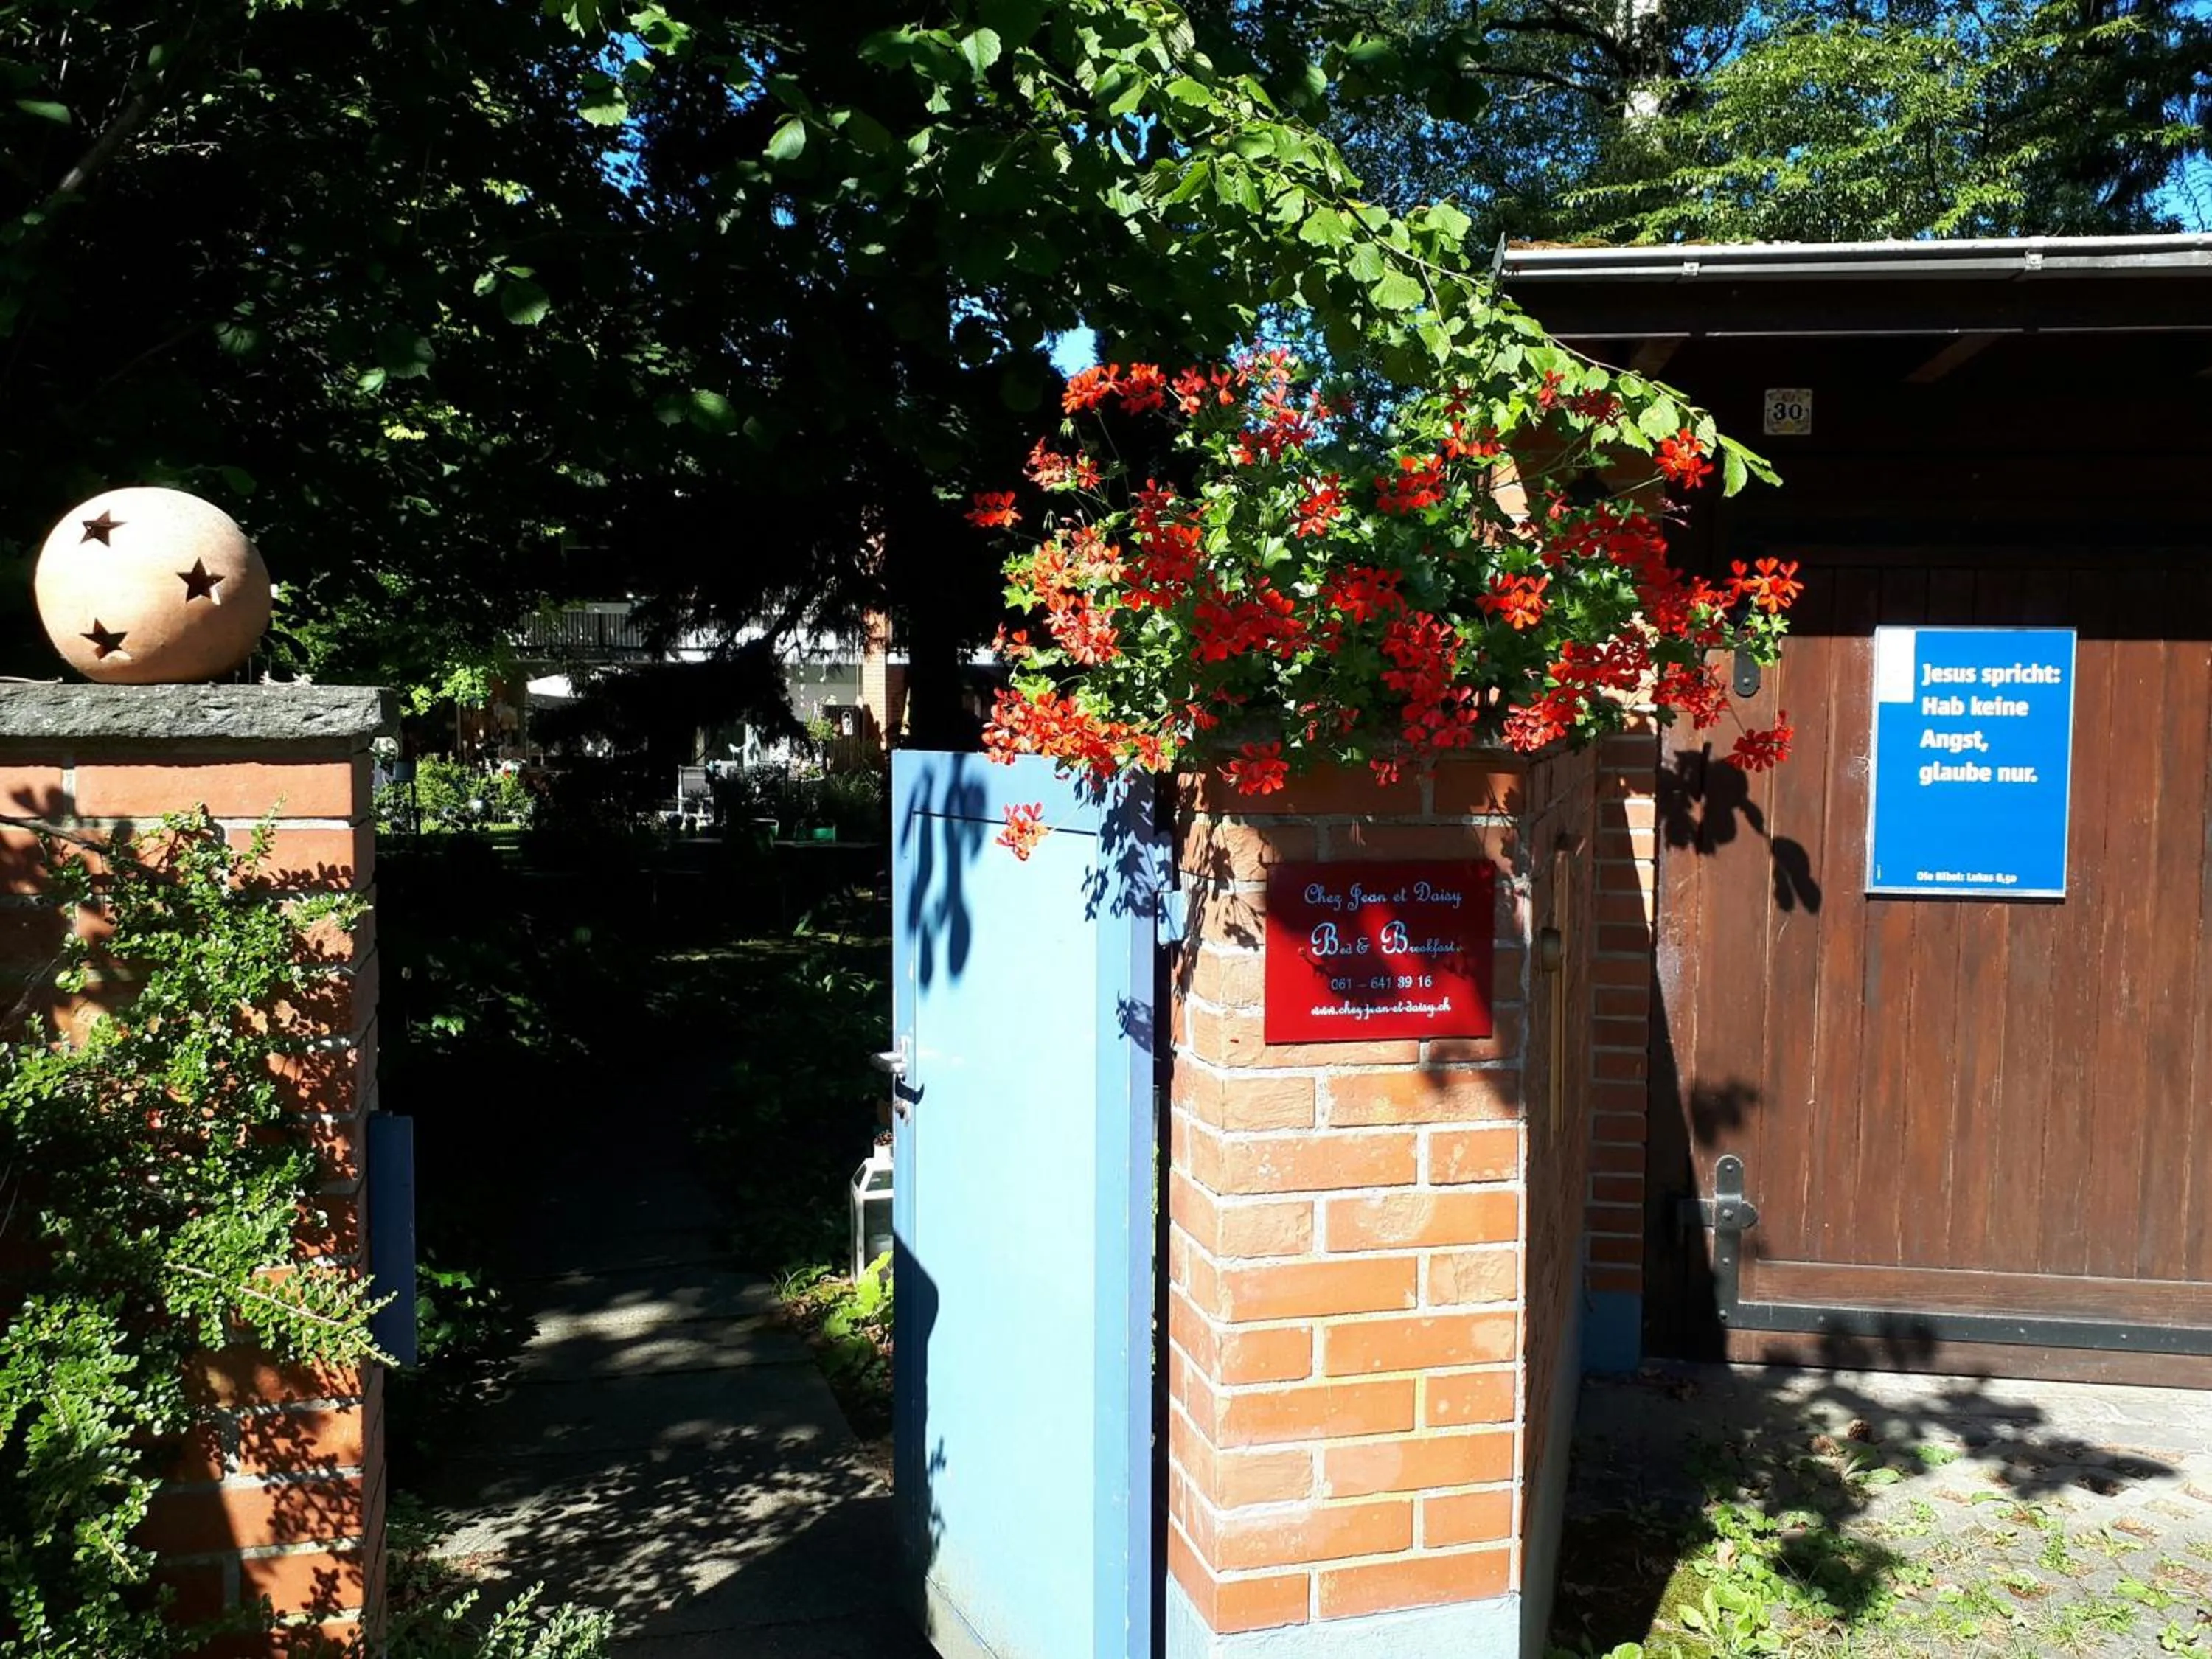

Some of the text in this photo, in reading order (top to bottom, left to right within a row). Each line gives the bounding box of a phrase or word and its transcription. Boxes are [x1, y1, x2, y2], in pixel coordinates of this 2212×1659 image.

[1773, 402, 1802, 420] 30
[1921, 662, 2061, 687] Jesus spricht:
[1921, 696, 2029, 716] Hab keine
[1919, 729, 1989, 752] Angst,
[1919, 761, 2038, 785] glaube nur.
[1304, 881, 1462, 911] Chez Jean et Daisy
[1311, 920, 1454, 958] Bed & Breakfast
[1331, 978, 1352, 990] 061
[1370, 977, 1391, 989] 641
[1397, 975, 1413, 989] 89
[1417, 975, 1433, 988] 16
